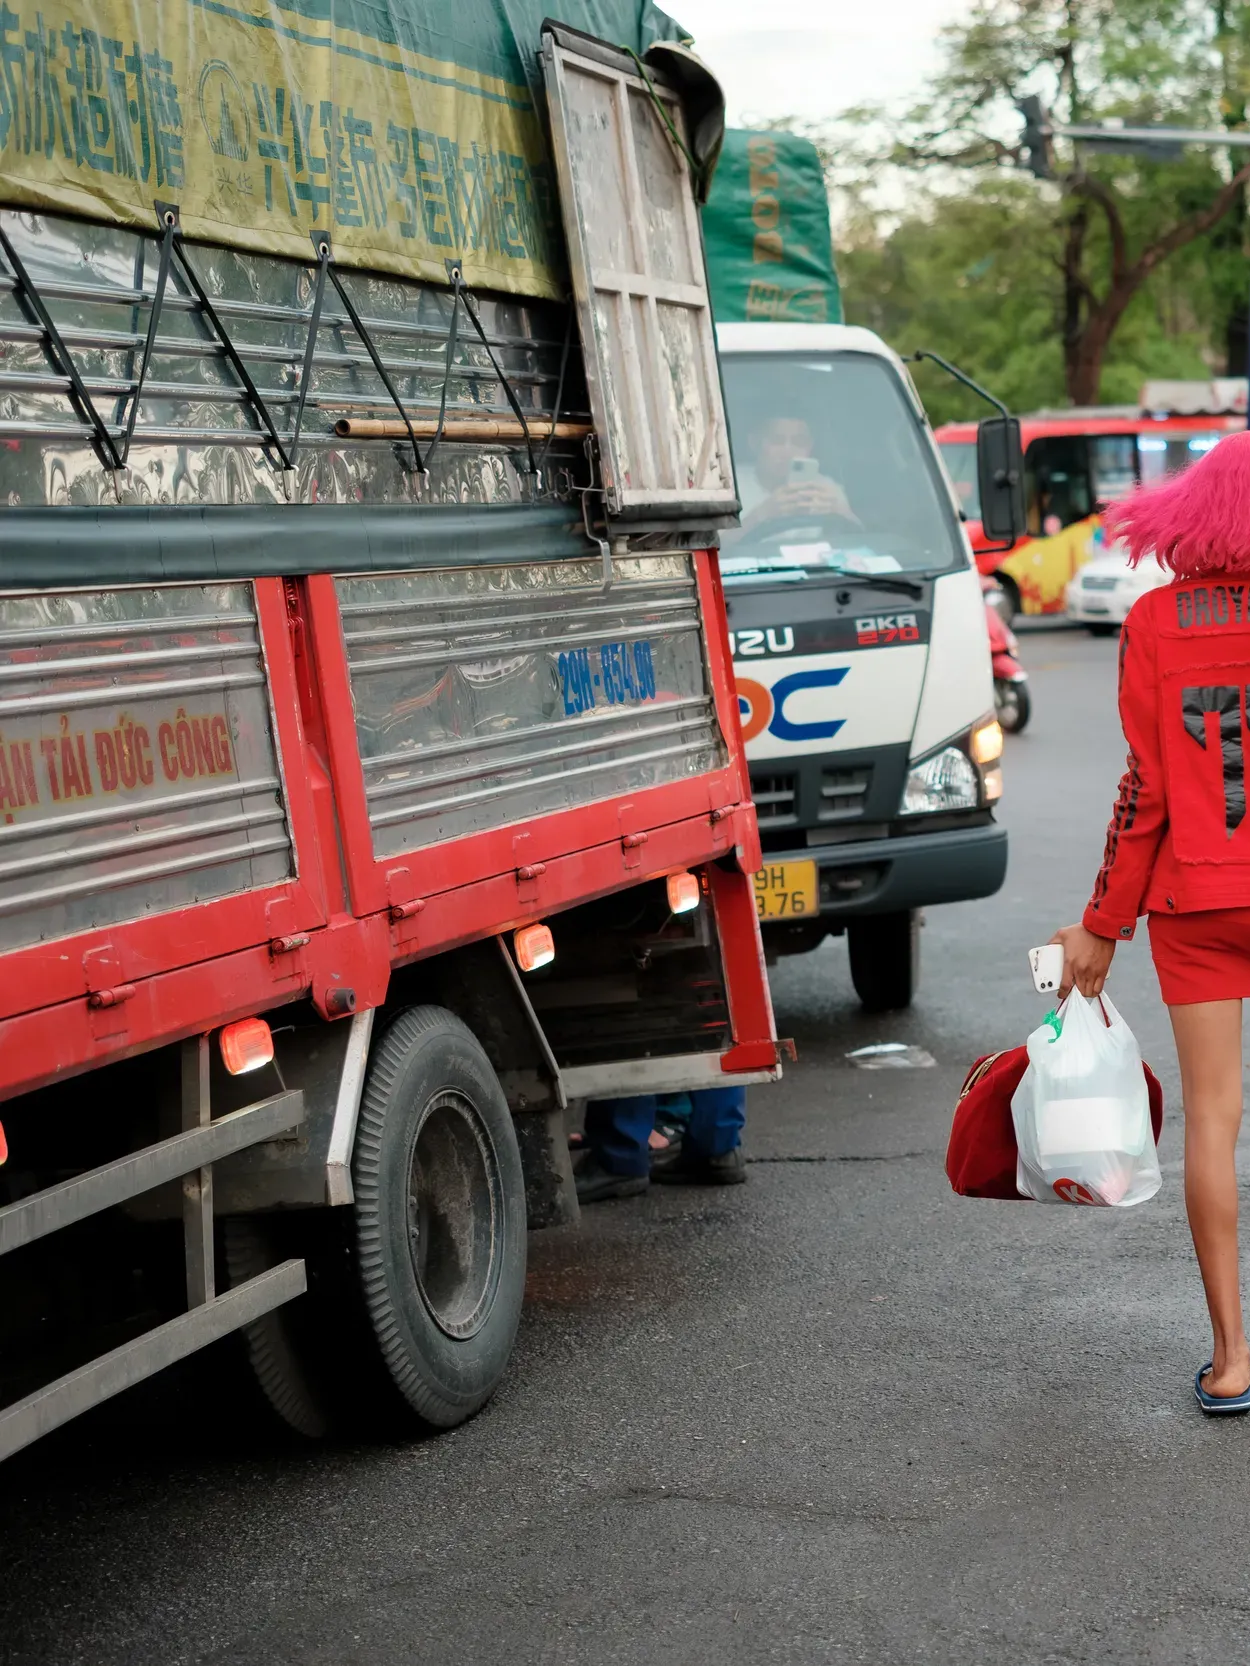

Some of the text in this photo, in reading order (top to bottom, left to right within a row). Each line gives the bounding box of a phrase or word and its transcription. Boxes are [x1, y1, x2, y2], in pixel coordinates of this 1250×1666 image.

[856, 613, 917, 633] QKR
[729, 626, 795, 656] ZU
[857, 627, 919, 645] 270
[41, 714, 93, 801] TẢI
[94, 712, 154, 793] ĐỨC
[158, 707, 233, 782] CÔNG
